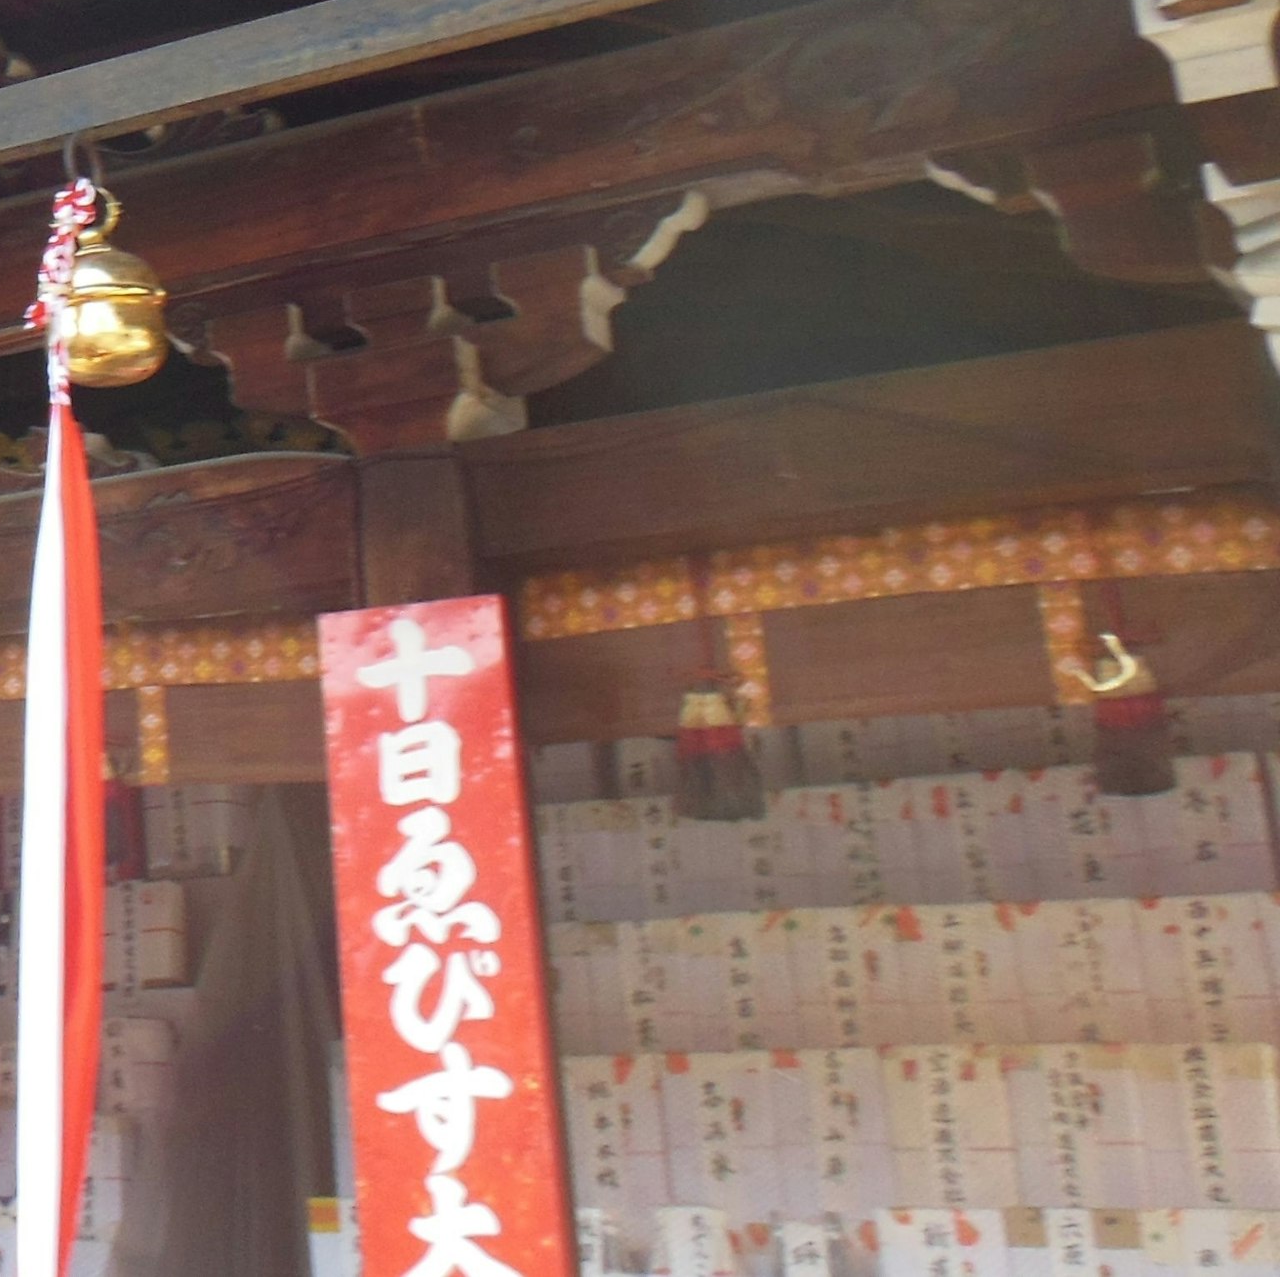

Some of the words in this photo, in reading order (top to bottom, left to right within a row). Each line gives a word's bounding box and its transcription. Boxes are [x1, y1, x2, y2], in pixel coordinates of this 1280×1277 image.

[357, 620, 524, 1277] 十日ゑびす大
